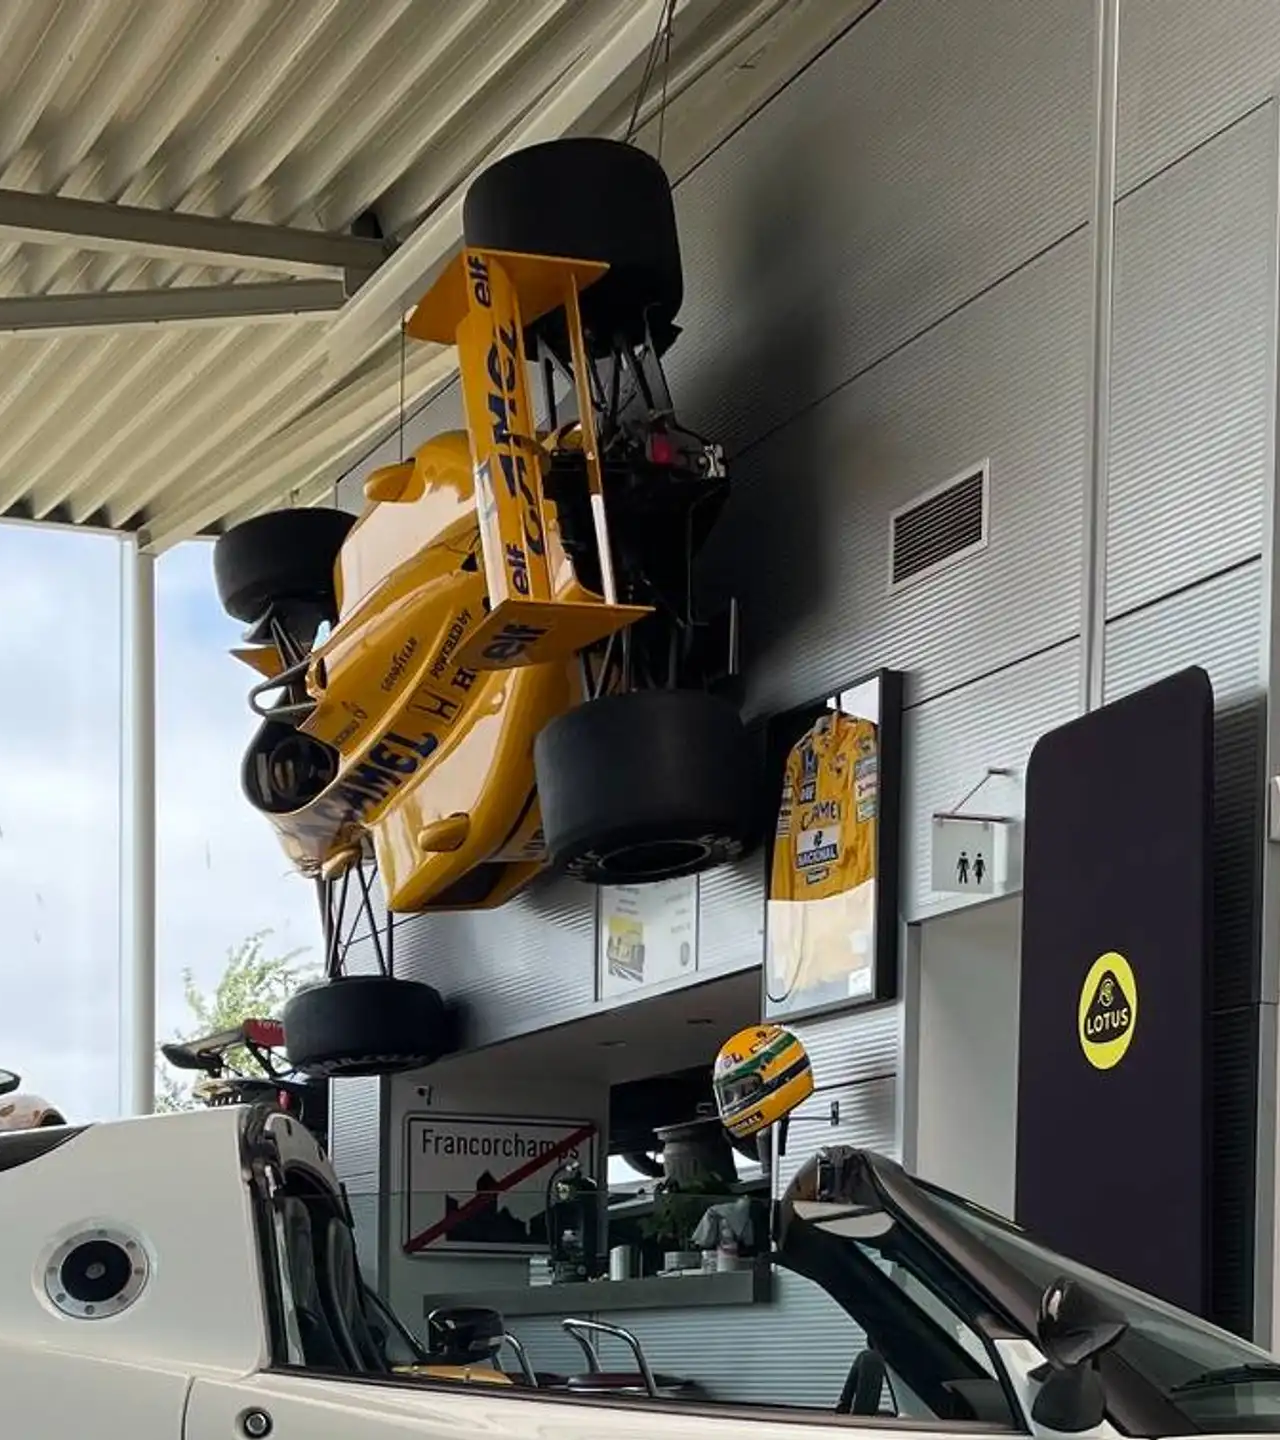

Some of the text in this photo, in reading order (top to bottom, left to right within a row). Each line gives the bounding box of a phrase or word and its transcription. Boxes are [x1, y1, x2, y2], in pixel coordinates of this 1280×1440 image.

[467, 255, 491, 308] elf
[487, 317, 545, 556] CAMEL
[506, 542, 529, 595] elf
[484, 624, 550, 660] elf
[1086, 1007, 1129, 1035] LOTUS
[422, 1129, 580, 1164] Francorchamps
